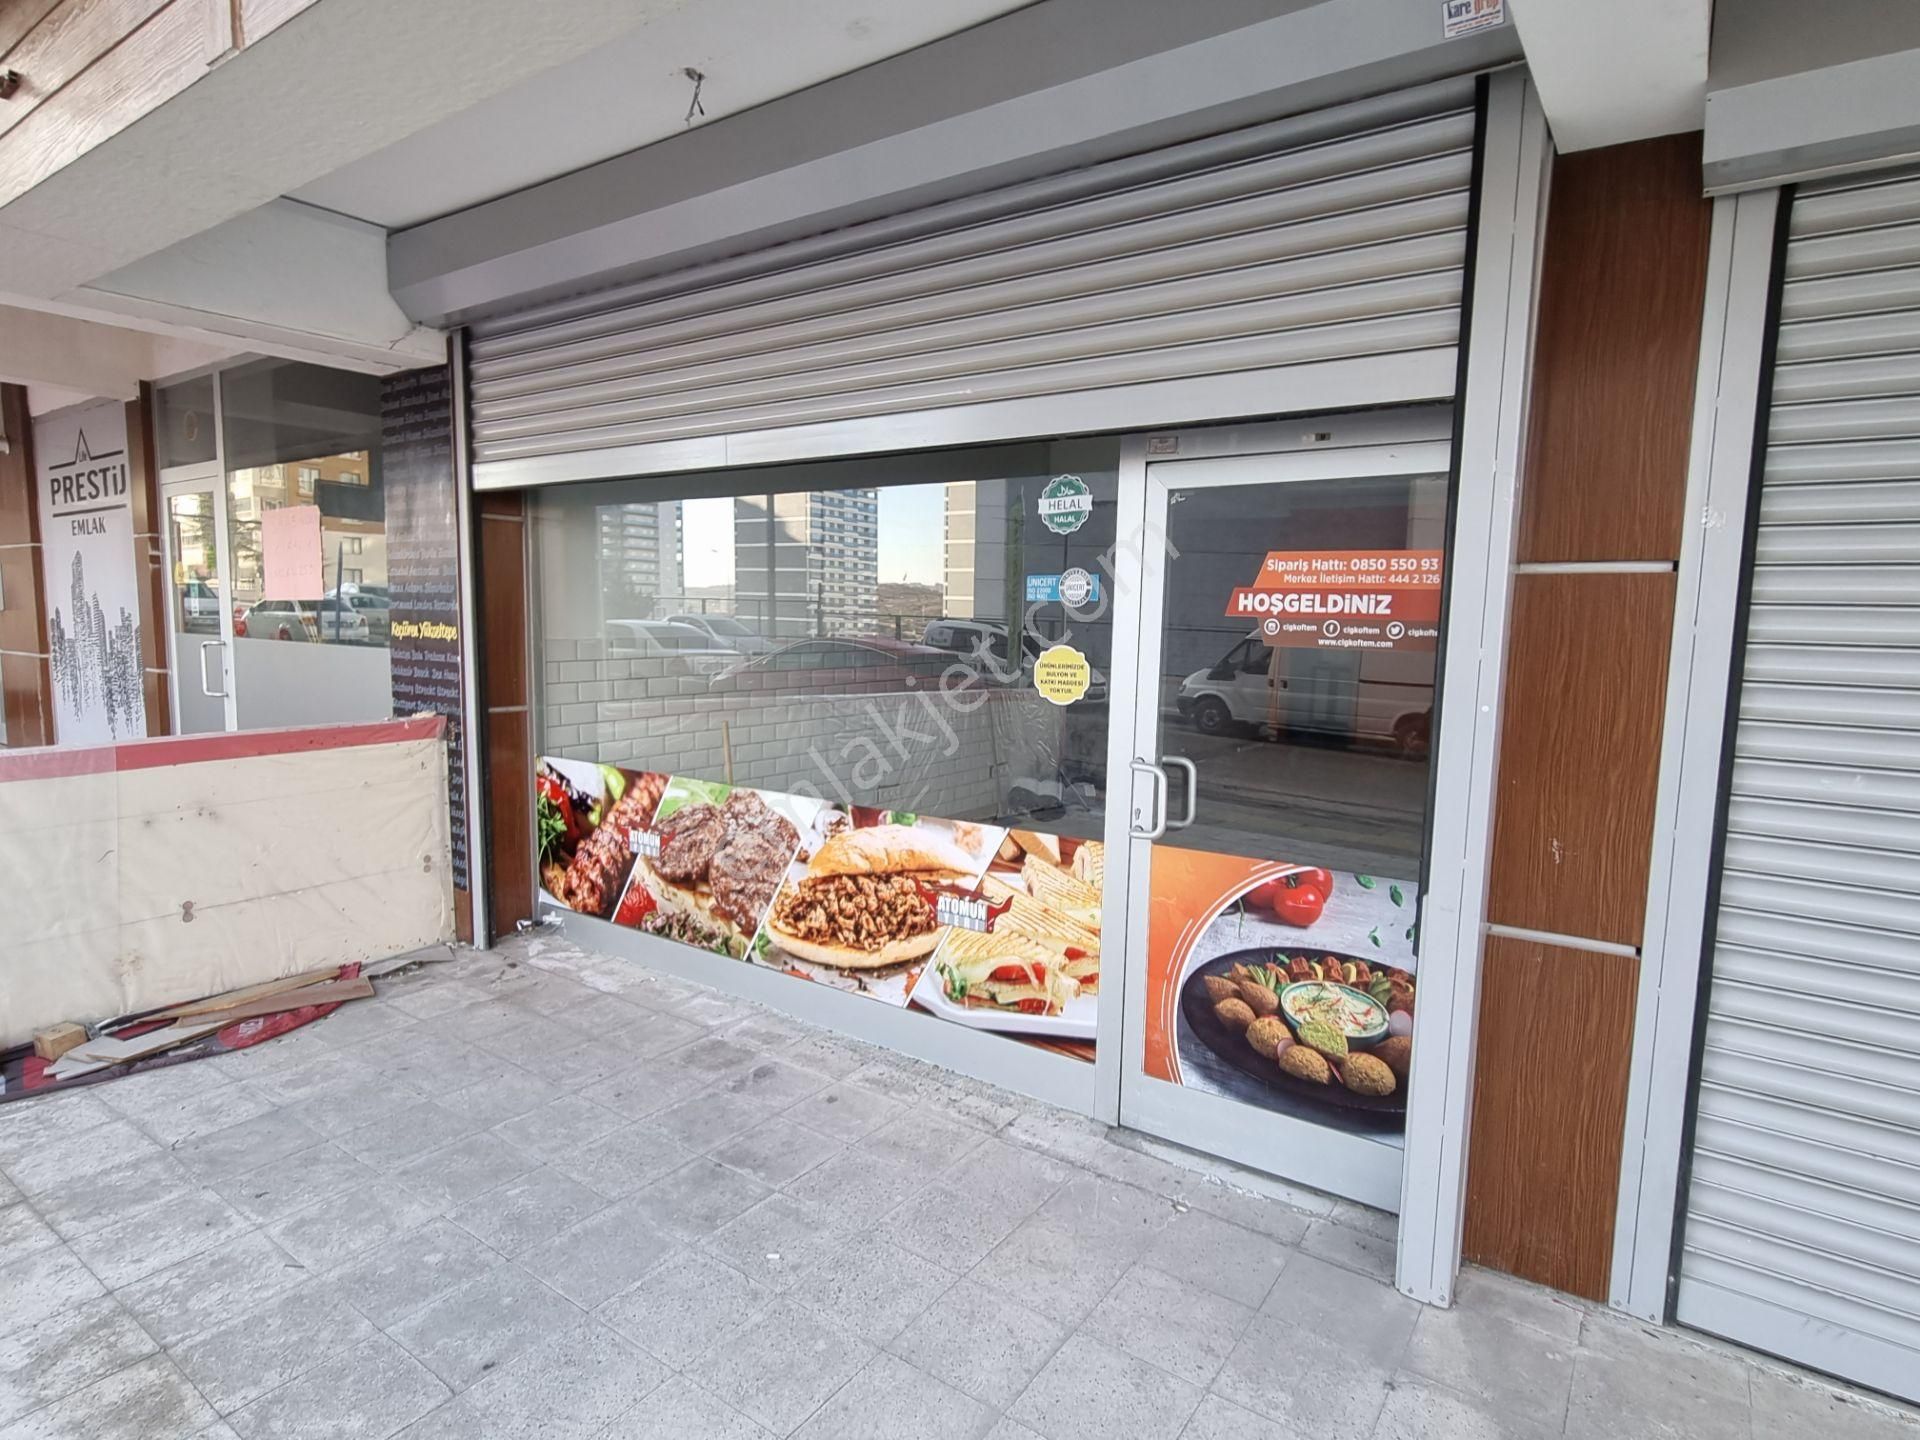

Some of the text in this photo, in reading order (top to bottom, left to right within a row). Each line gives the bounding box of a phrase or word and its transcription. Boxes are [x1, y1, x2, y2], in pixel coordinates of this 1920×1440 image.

[1048, 498, 1083, 511] HELAL
[1054, 514, 1076, 523] HALAL
[71, 516, 106, 536] EMLAK
[1267, 558, 1439, 572] Sipariş Hattı: 0850 550 93
[1027, 577, 1057, 587] UNICERT
[1283, 574, 1317, 584] Merkez
[1358, 574, 1386, 584] Hattı:
[1388, 574, 1409, 584] 444
[1412, 574, 1419, 584] 2
[1422, 574, 1440, 584] 126
